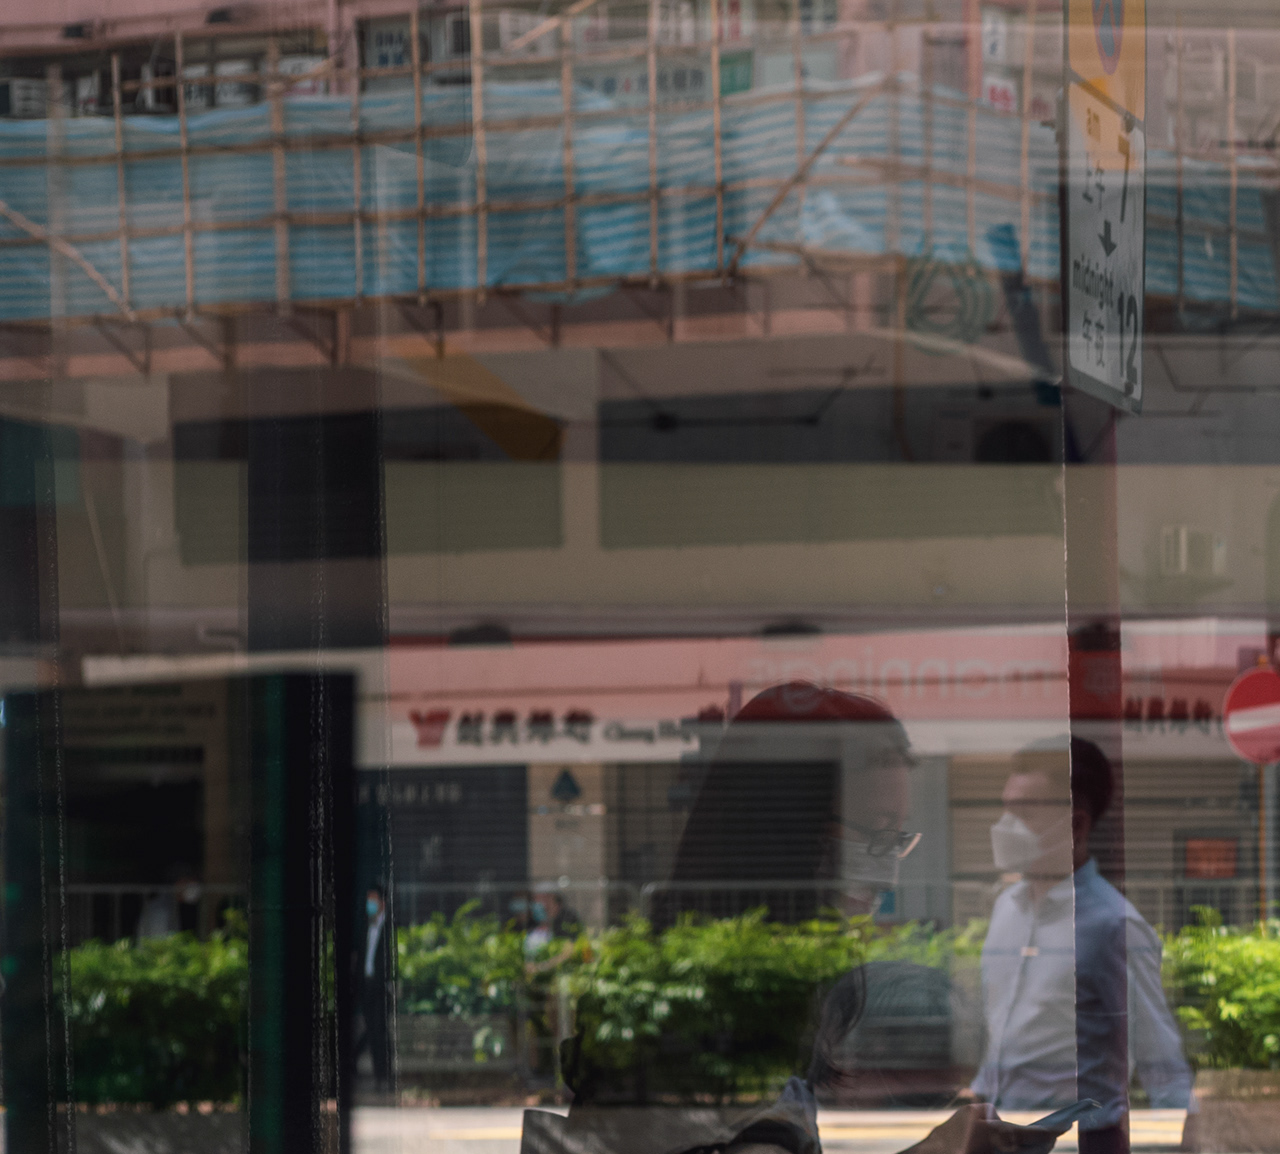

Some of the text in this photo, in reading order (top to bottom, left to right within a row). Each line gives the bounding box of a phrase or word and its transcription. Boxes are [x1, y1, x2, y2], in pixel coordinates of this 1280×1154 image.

[1117, 133, 1131, 224] 7
[1072, 252, 1114, 311] midnight
[1117, 291, 1139, 385] 12
